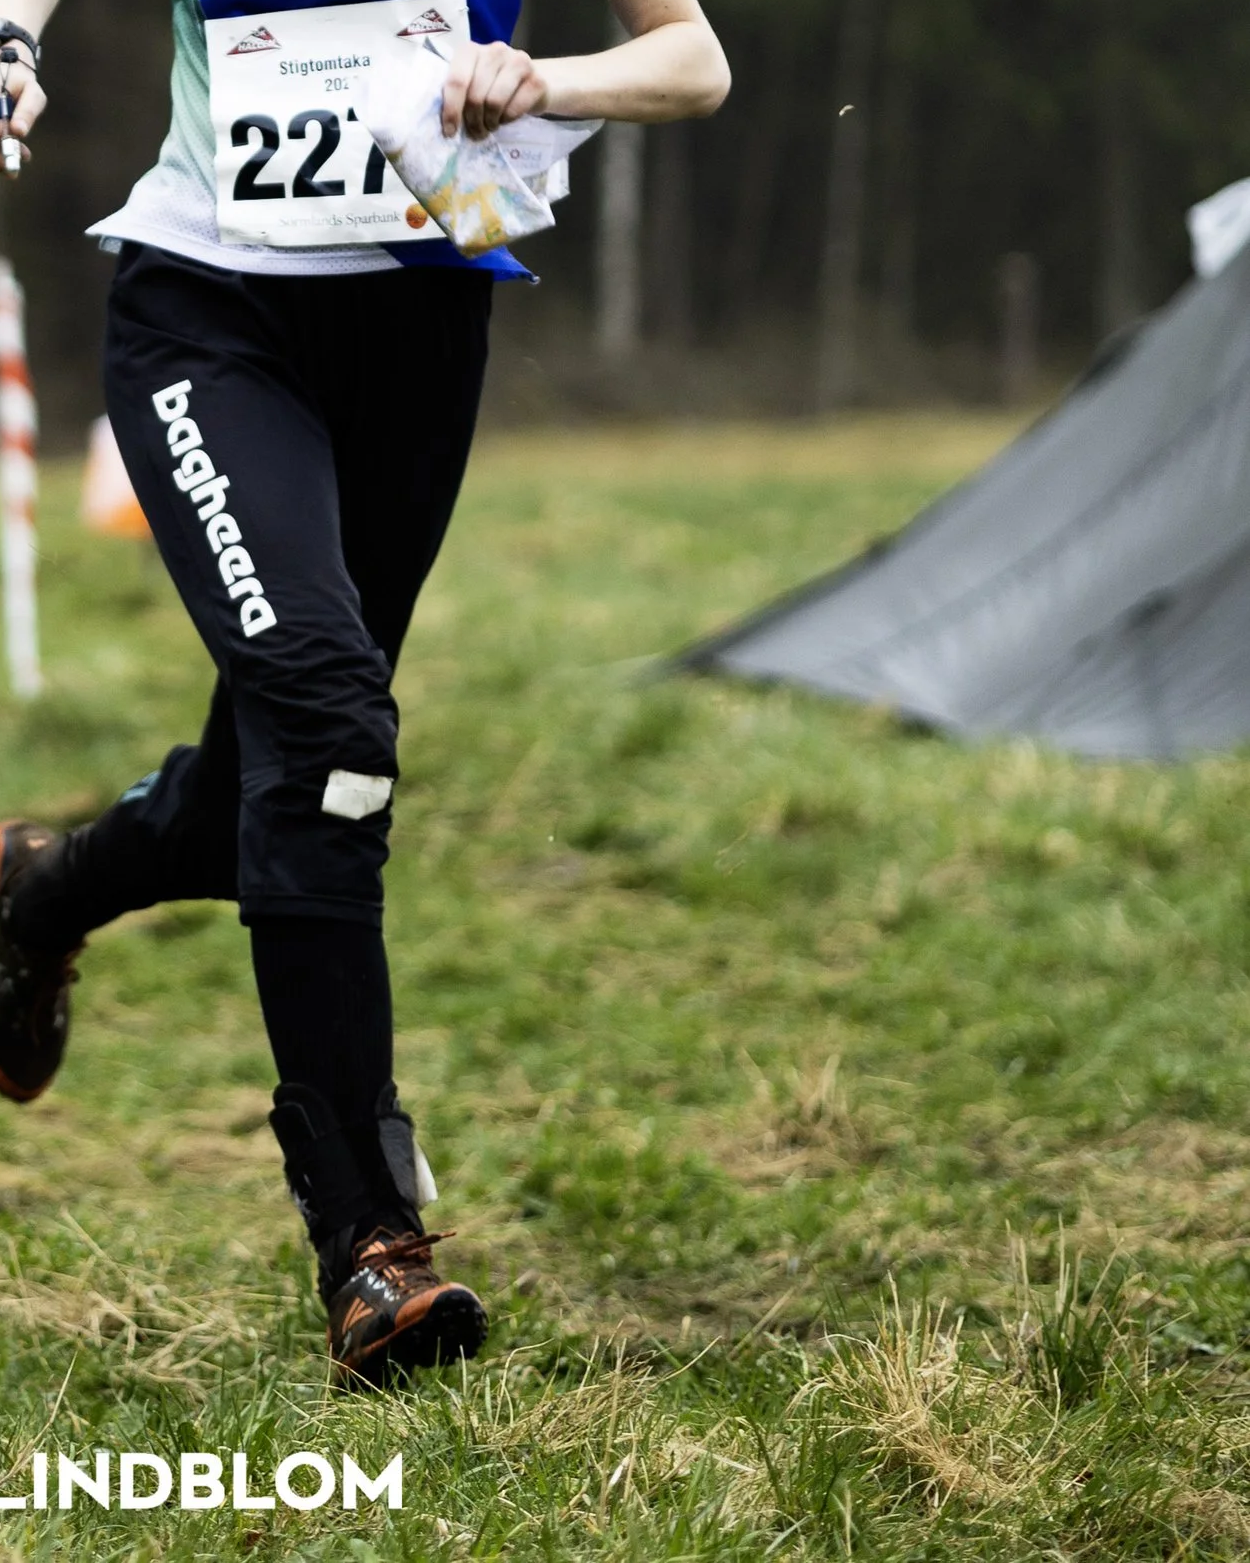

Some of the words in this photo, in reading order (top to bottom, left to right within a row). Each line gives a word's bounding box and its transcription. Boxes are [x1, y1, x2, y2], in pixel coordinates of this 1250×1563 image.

[279, 54, 371, 76] Stigtomtaka
[324, 75, 359, 92] 202
[345, 211, 402, 227] Sparbank
[152, 379, 278, 638] bagheera
